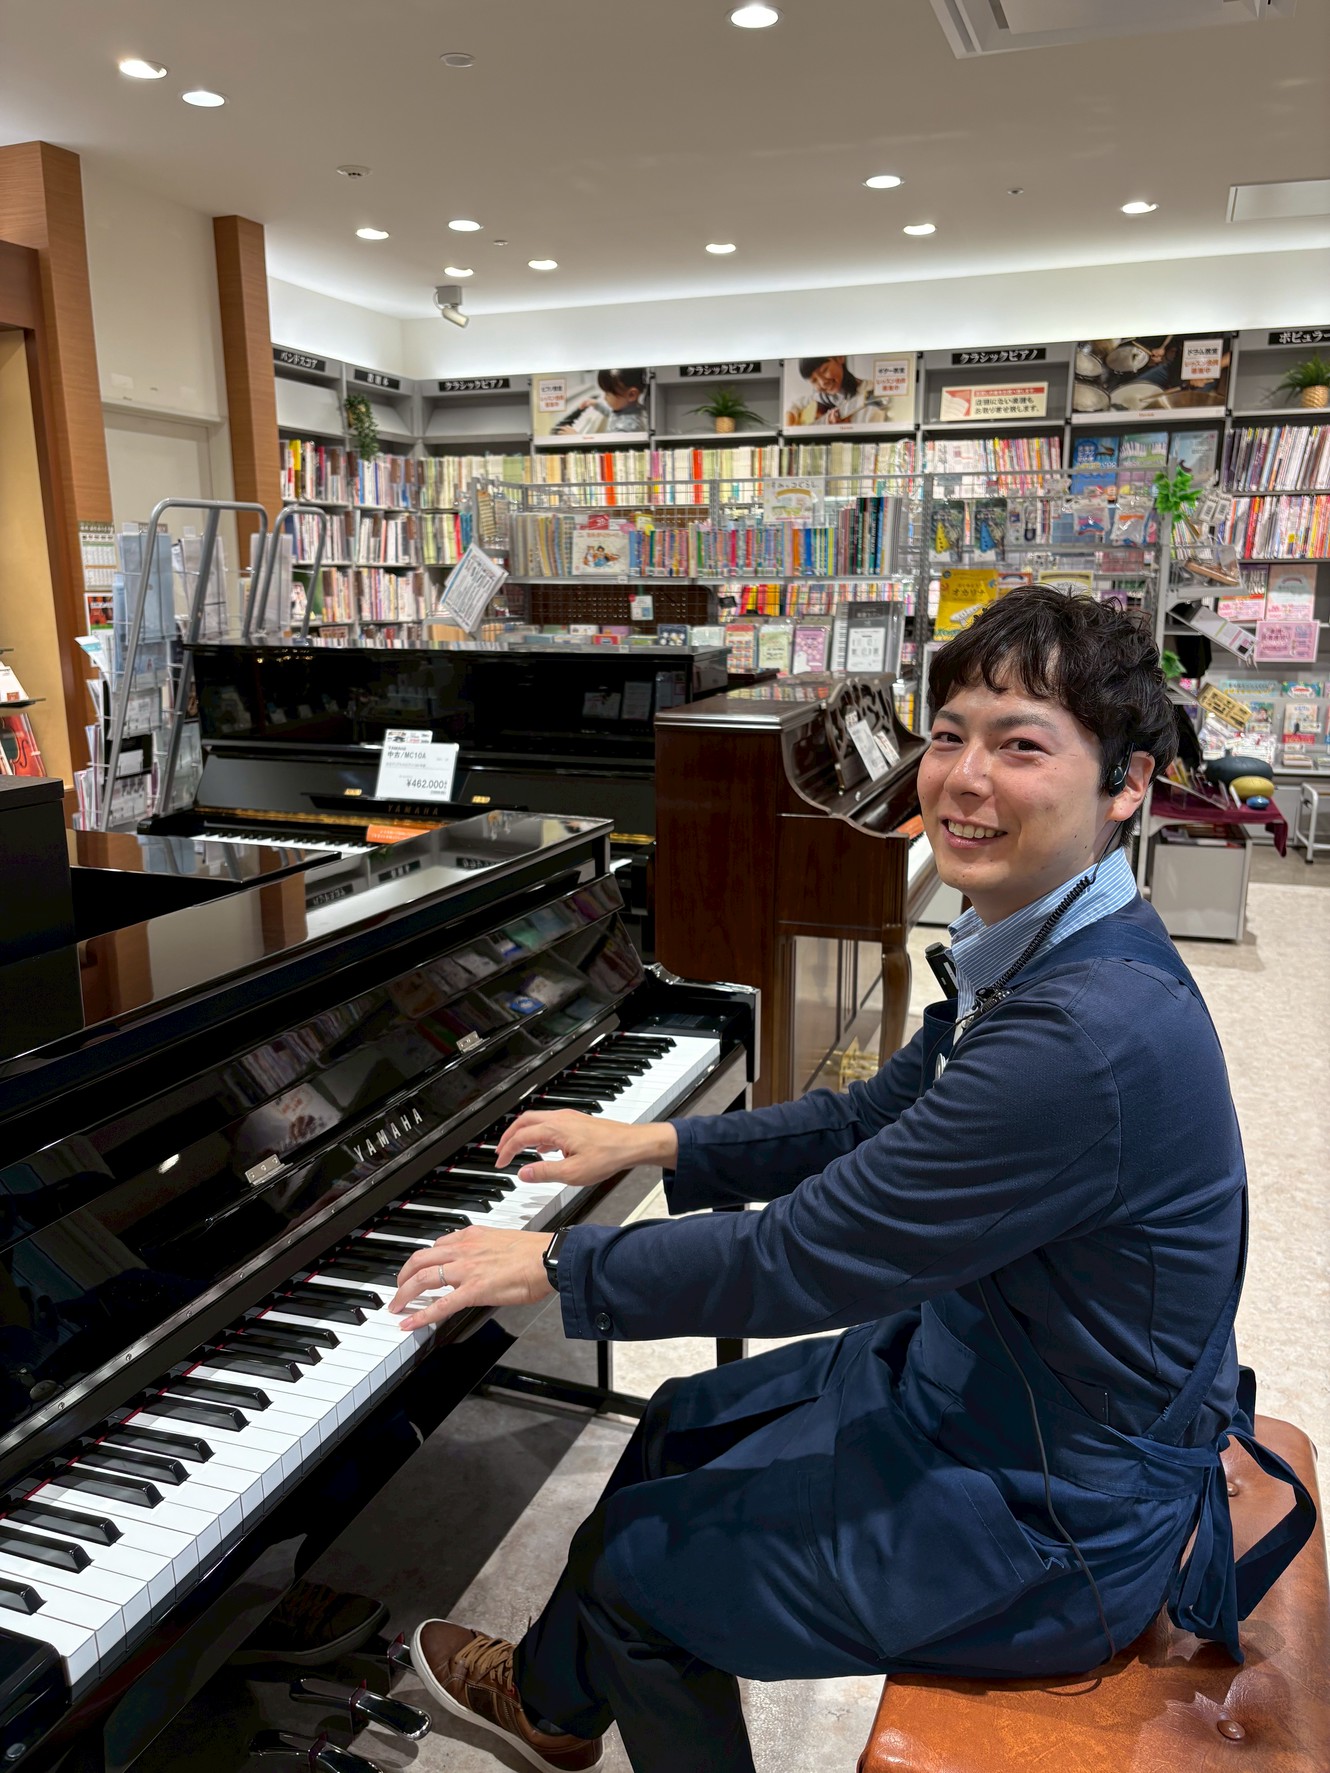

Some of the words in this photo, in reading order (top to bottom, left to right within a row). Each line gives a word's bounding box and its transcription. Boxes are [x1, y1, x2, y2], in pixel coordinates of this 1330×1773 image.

[280, 352, 318, 369] バンドスコア
[959, 350, 1038, 365] クラシックピアノ
[686, 364, 754, 377] クラシックピアノ
[444, 379, 504, 391] クラシックピアノ
[387, 804, 438, 816] YAMAHA
[353, 1108, 423, 1162] YAMAHA
